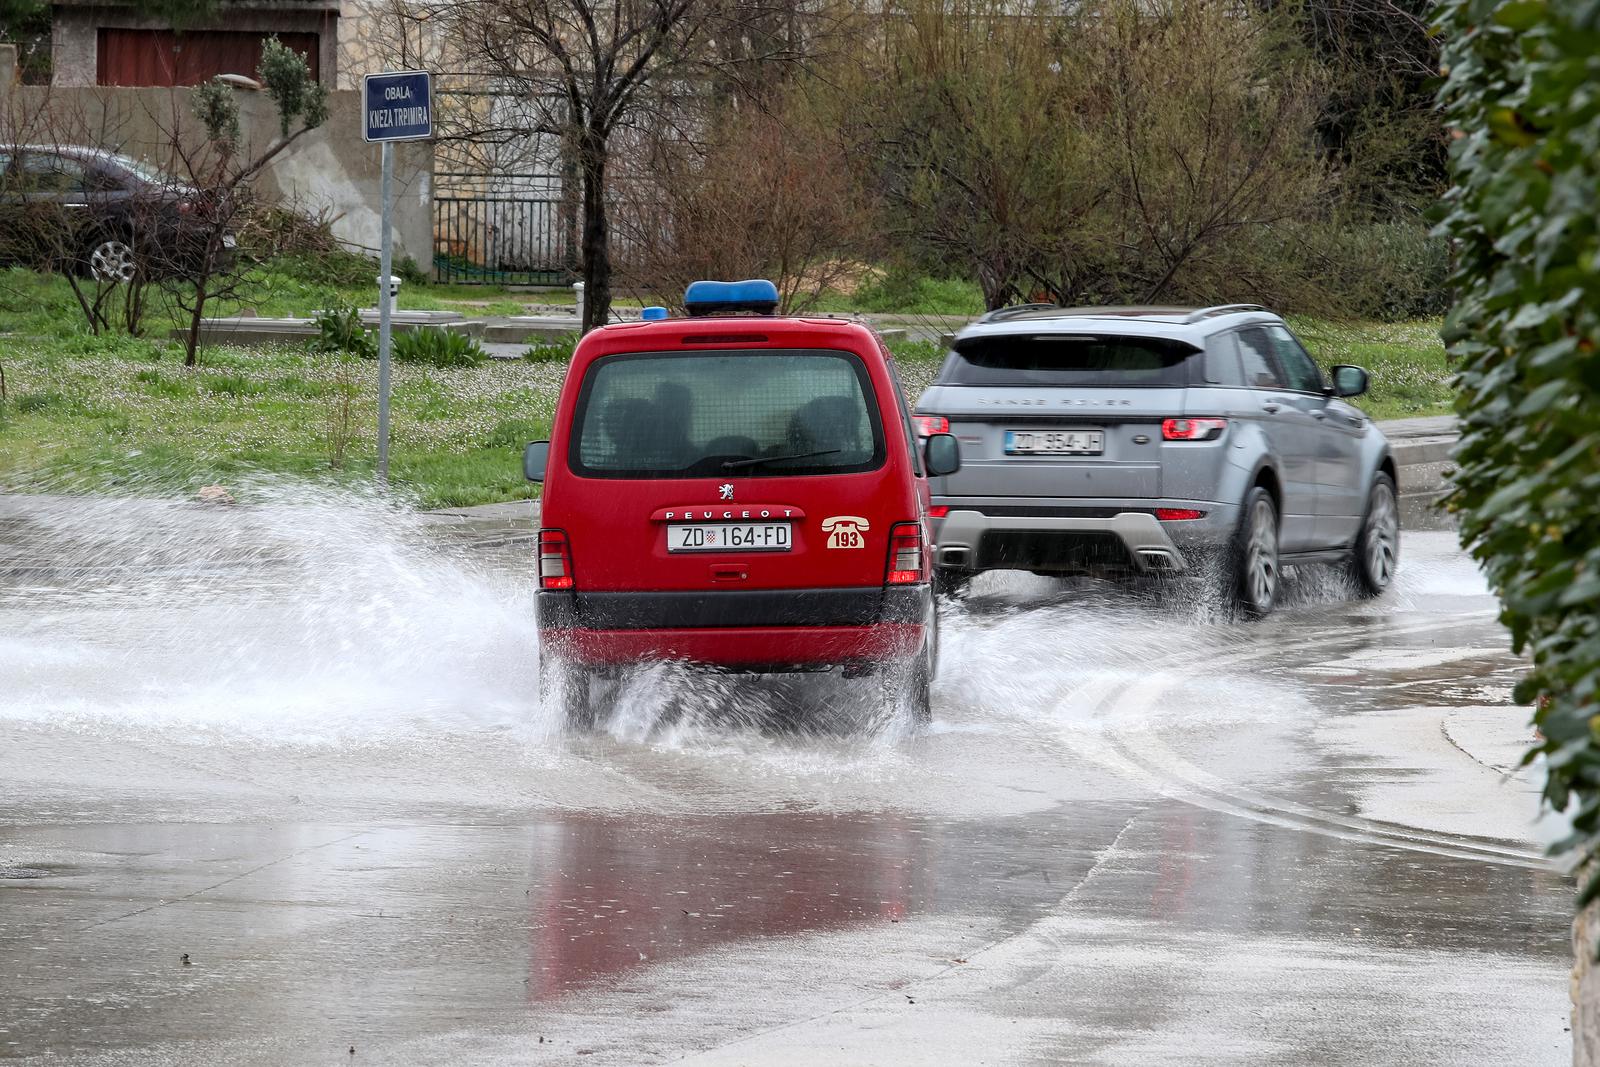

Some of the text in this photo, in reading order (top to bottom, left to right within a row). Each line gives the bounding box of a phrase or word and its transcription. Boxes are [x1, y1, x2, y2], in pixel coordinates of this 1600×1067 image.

[385, 86, 410, 100] OBALA
[370, 106, 428, 128] KNEZA TRPIMIRA
[1061, 398, 1132, 407] ROVER
[665, 509, 792, 520] PEUGEOT
[681, 526, 787, 547] ZD 164-FD
[833, 531, 859, 548] 193
